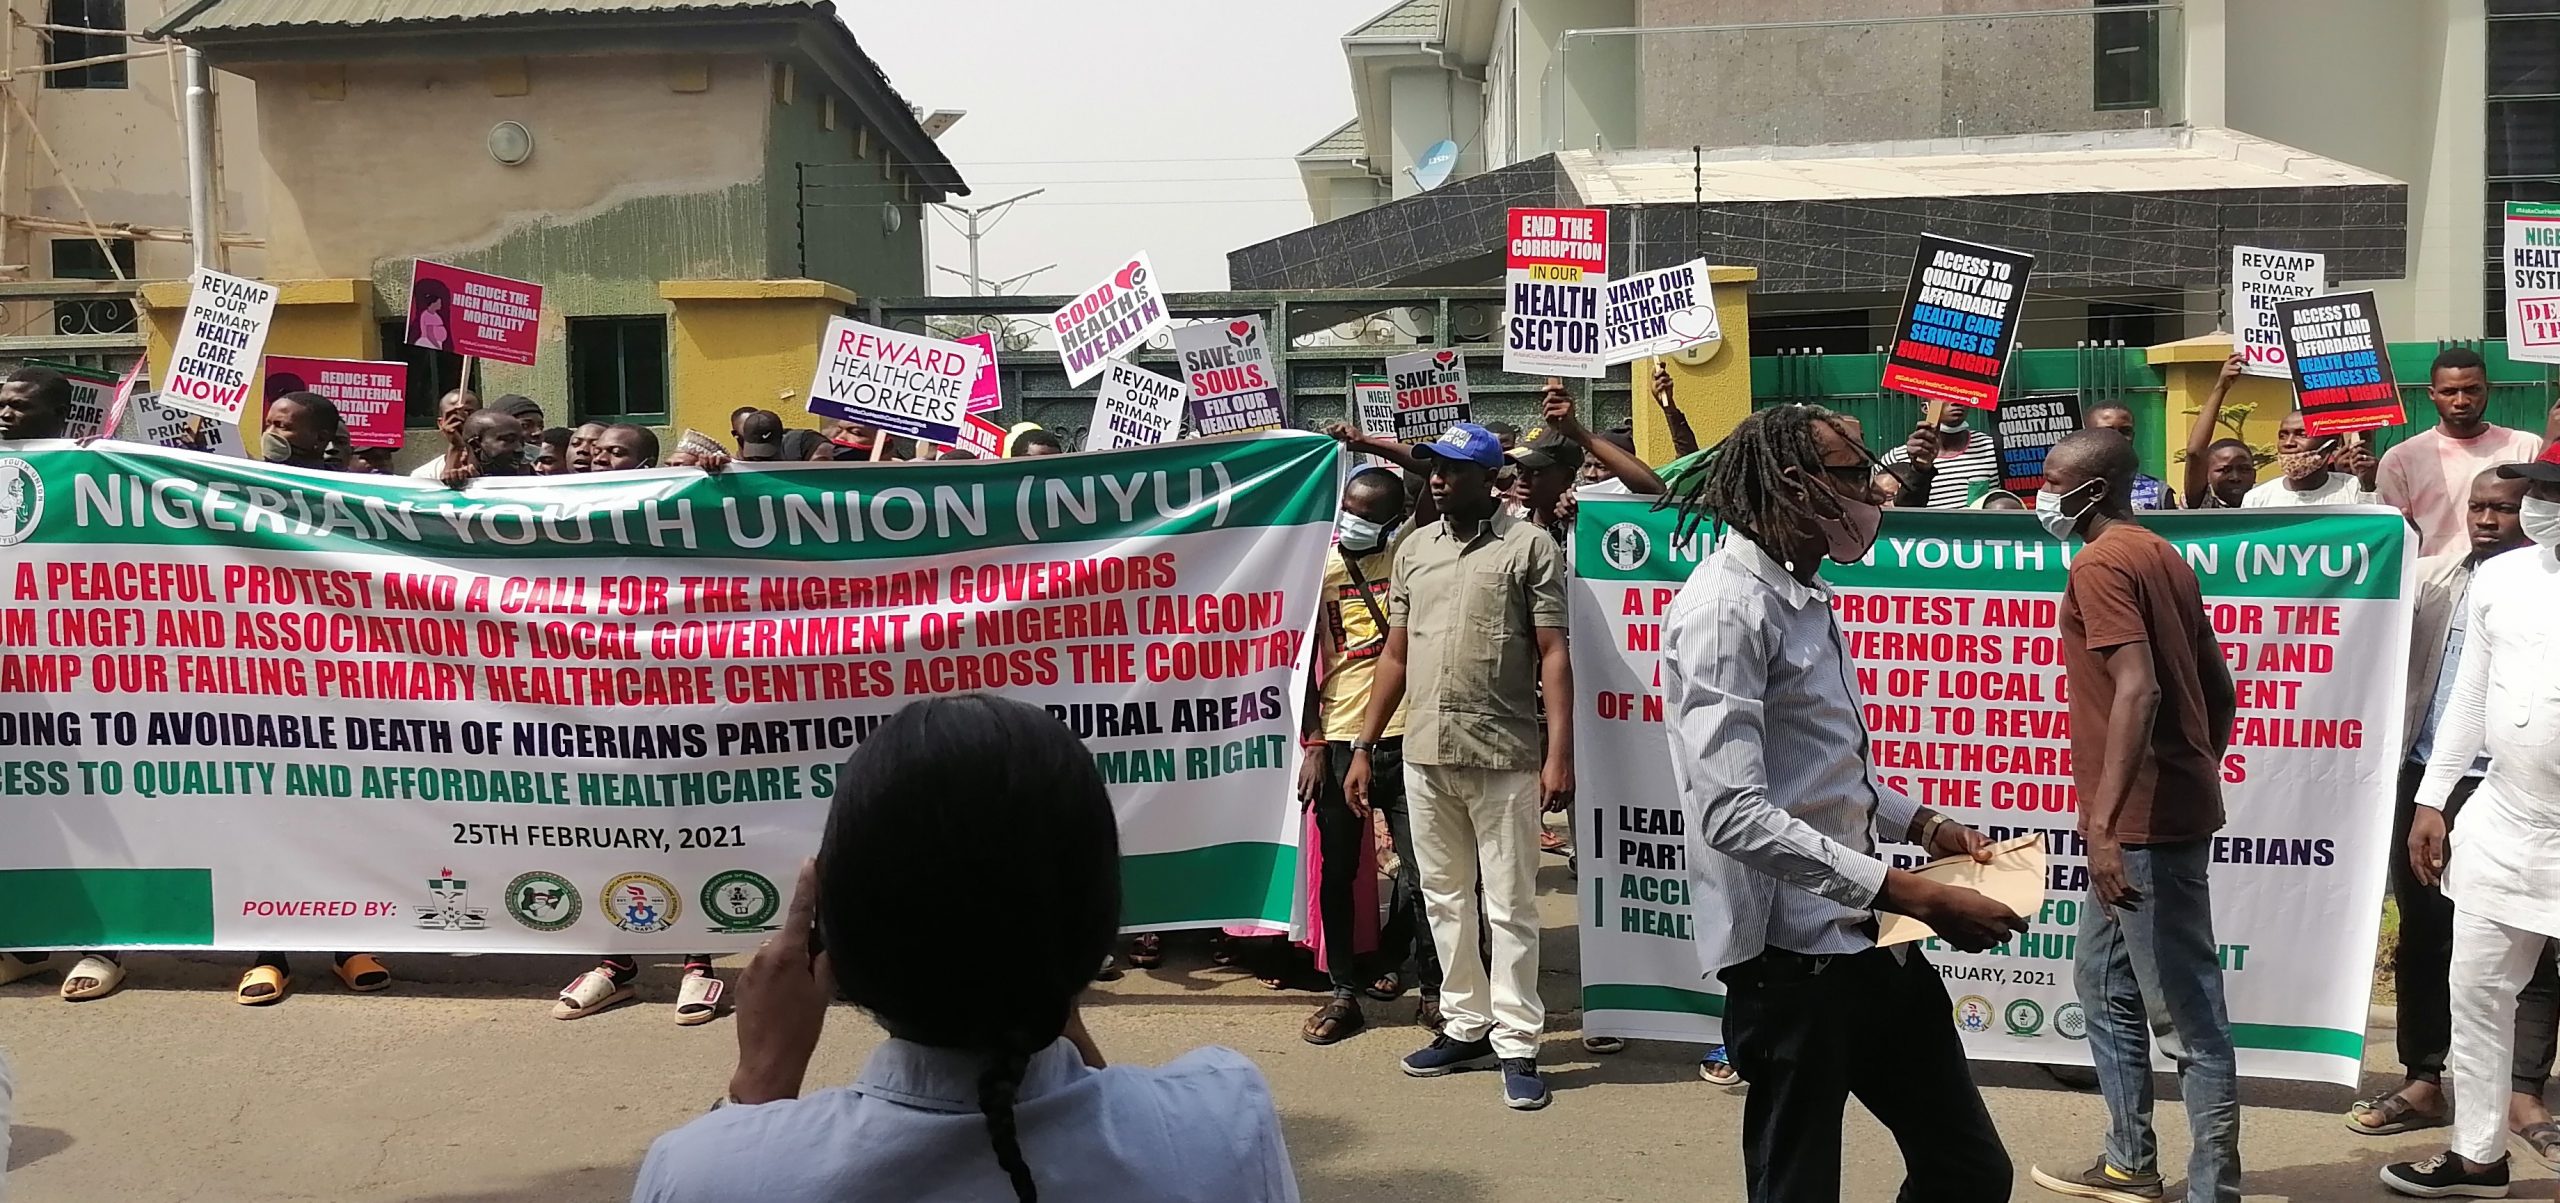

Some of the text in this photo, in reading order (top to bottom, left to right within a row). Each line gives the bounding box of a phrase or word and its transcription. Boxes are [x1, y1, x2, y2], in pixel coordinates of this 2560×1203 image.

[1521, 216, 1593, 240] END THE
[1511, 239, 1602, 261] CORRUPTION
[2242, 253, 2315, 272] REVAMP
[1534, 266, 1577, 281] IN OUR
[1660, 267, 1695, 292] OUR
[1932, 250, 2011, 281] ACCESS TO
[2260, 270, 2295, 282] OUR
[202, 275, 268, 305] REVAMP
[465, 282, 530, 306] REDUCE THE
[1922, 267, 2013, 301] QUALITY AND
[2242, 282, 2314, 297] PRIMARY
[214, 296, 247, 315] OUR
[452, 293, 538, 321] HIGH MATERNAL
[1055, 284, 1114, 334] GOOD
[1515, 283, 1597, 319] HEALTH
[1605, 289, 1695, 327] EALTHCARE
[1918, 286, 2007, 320] AFFORDABLE
[2293, 303, 2361, 326] ACCESS TO
[194, 306, 260, 333] PRIMARY
[463, 309, 525, 332] MORTALITY
[478, 325, 507, 342] RATE.
[1060, 285, 1149, 353] HEALTH IS
[1605, 316, 1667, 349] YSTEM
[1912, 304, 2003, 338] HEALTH CARE
[2290, 318, 2371, 342] QUALITY AND
[196, 321, 250, 350] HEALTH
[1067, 297, 1160, 374] WEALTH
[1510, 317, 1599, 354] SECTOR
[1910, 324, 1996, 356] SERVICES IS
[2296, 334, 2374, 358] AFFORDABLE
[198, 342, 237, 366] CARE
[838, 329, 966, 377] REWARD
[1185, 345, 1262, 372] SAVE OUR
[1896, 340, 2000, 376] HUMAN RIGHT!
[2297, 351, 2378, 374] HEALTH CARE
[179, 357, 244, 387] CENTRES
[321, 371, 393, 388] REDUCE THE
[832, 354, 962, 400] HEALTHCARE
[1112, 367, 1179, 402] REVAMP
[1191, 364, 1269, 397] SOULS,
[1395, 369, 1460, 390] SAVE OUR
[2303, 367, 2381, 390] SERVICES IS
[172, 375, 249, 412] NOW!
[309, 384, 403, 401] HIGH MATERNAL
[330, 399, 389, 414] ORTALITY
[829, 376, 957, 422] WORKERS
[1126, 390, 1158, 410] OUR
[1204, 392, 1268, 416] FIX OUR
[1397, 384, 1462, 409] SOULS,
[2301, 387, 2349, 407] HUMAN
[1106, 397, 1172, 431] PRIMARY
[1200, 408, 1281, 435] HEALTH CARE
[1404, 406, 1459, 425] FIX OUR
[1999, 416, 2073, 435] QUALITY AND
[2002, 402, 2065, 420] ACCESS TO
[977, 429, 997, 450] THE
[1109, 414, 1161, 444] HEALTH
[1398, 422, 1437, 439] HEALTH
[2004, 447, 2045, 463] HEALTH
[74, 461, 1232, 550] NIGERIAN YOUTH UNION (NYU)
[1889, 537, 2044, 571] YOUTH
[2235, 540, 2370, 585] (NYU)
[15, 552, 1177, 616] A PEACEFUL PROTEST AND A CALL FOR THE NIGERIAN GOVERNORS
[1622, 588, 1644, 616] A
[1983, 598, 2055, 629] AND
[48, 608, 146, 647] (NGF)
[156, 610, 225, 649] AND
[235, 612, 469, 657] ASSOCIATION
[476, 620, 521, 659] OF
[528, 622, 644, 660] LOCAL
[651, 615, 915, 661] GOVERNMENT
[920, 612, 968, 652] OF
[975, 599, 1129, 647] NIGERIA
[1137, 590, 1284, 636] (ALGON)
[2273, 605, 2340, 636] THE
[92, 654, 169, 694] OUR
[177, 655, 306, 697] FAILING
[315, 659, 476, 701] PRIMARY
[485, 665, 716, 707] HEALTHCARE
[723, 660, 895, 705] CENTRES
[904, 646, 1059, 696] ACROSS
[1067, 643, 1136, 685] THE
[1145, 630, 1306, 683] COUNTRY.
[2256, 643, 2334, 674] AND
[1888, 668, 2045, 703] OF LOCAL
[1046, 685, 1282, 739] RURAL AREAS
[1598, 691, 1634, 721] OF
[1931, 706, 1975, 736] TO
[90, 712, 708, 760] TO AVOIDABLE DEATH OF NIGERIANS
[2229, 717, 2363, 749] FAILING
[1186, 734, 1286, 781] RIGHT
[78, 761, 801, 807] TO QUALITY AND AFFORDABLE HEALTHCARE
[1918, 777, 1981, 808] THE
[452, 822, 746, 853] 25TH FEBRUARY, 2021
[242, 901, 397, 918] POWERED BY:
[2012, 970, 2057, 986] 2021
